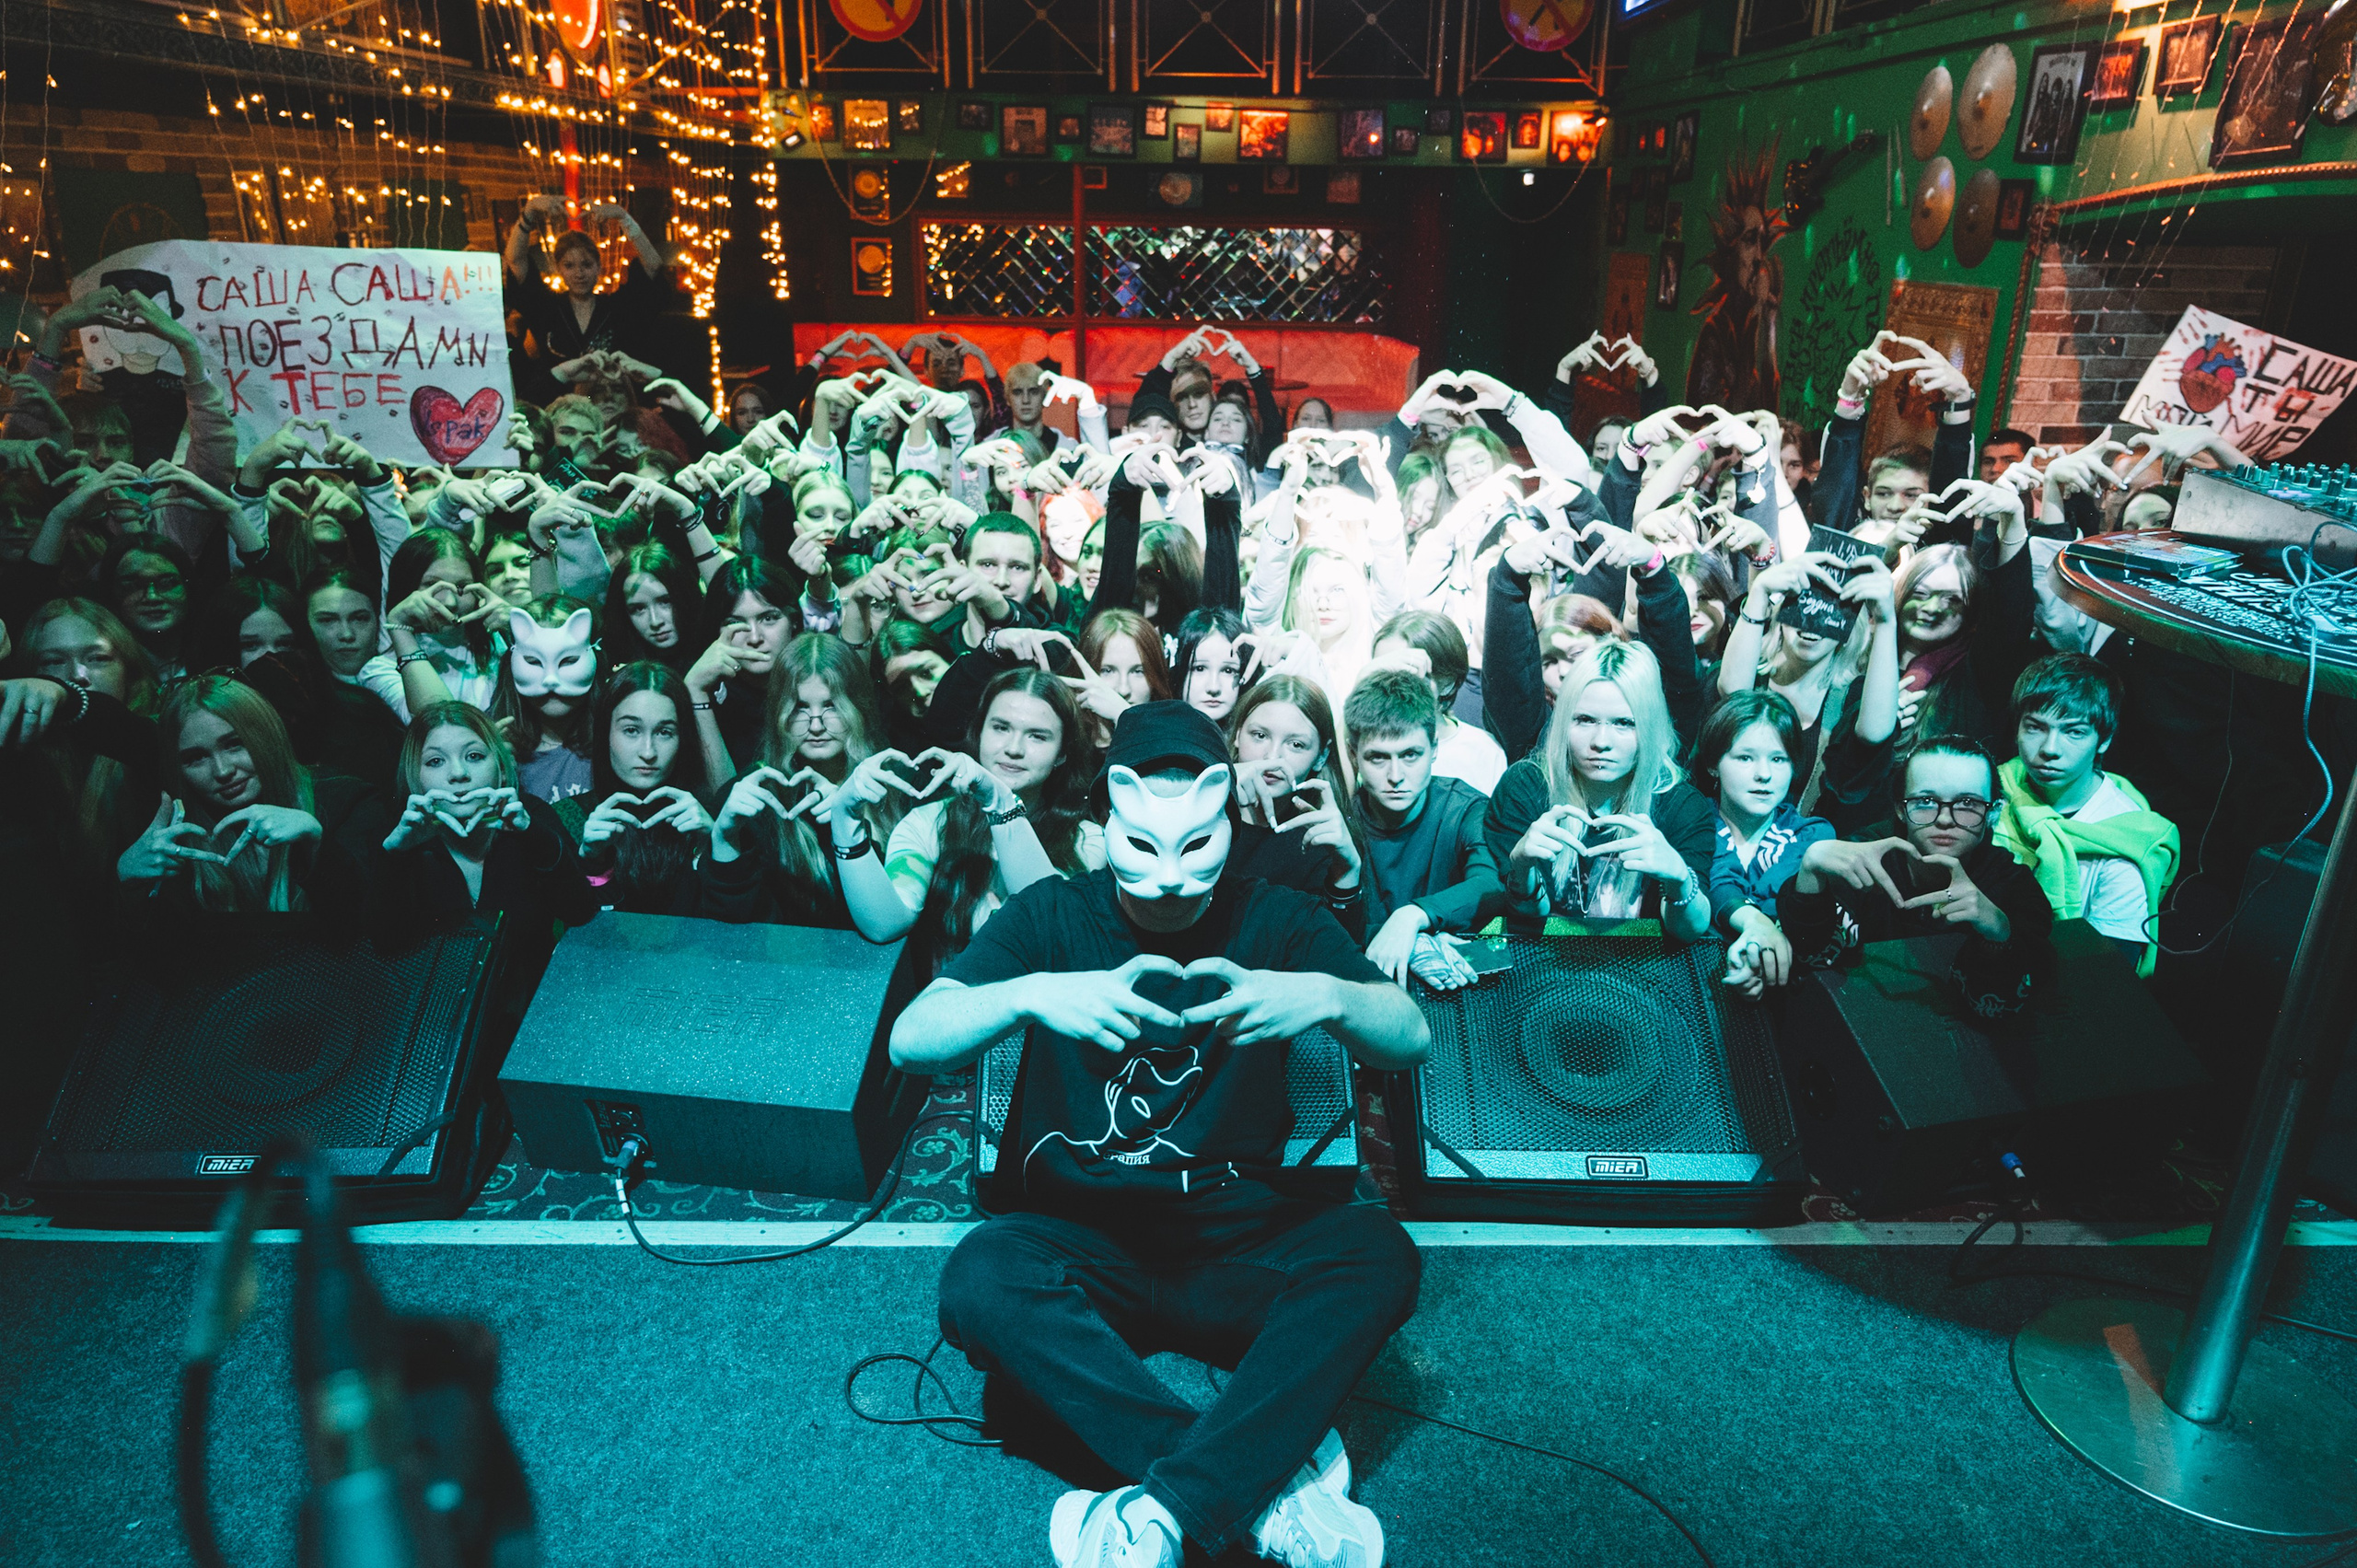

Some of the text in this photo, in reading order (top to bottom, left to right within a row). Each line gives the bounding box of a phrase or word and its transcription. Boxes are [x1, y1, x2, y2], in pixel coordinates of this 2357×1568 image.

[196, 269, 316, 312] САША
[225, 368, 407, 415] К ТЕБЕ
[2252, 340, 2357, 399] САША
[2244, 383, 2316, 424] ТЫ
[2218, 412, 2312, 458] МИР
